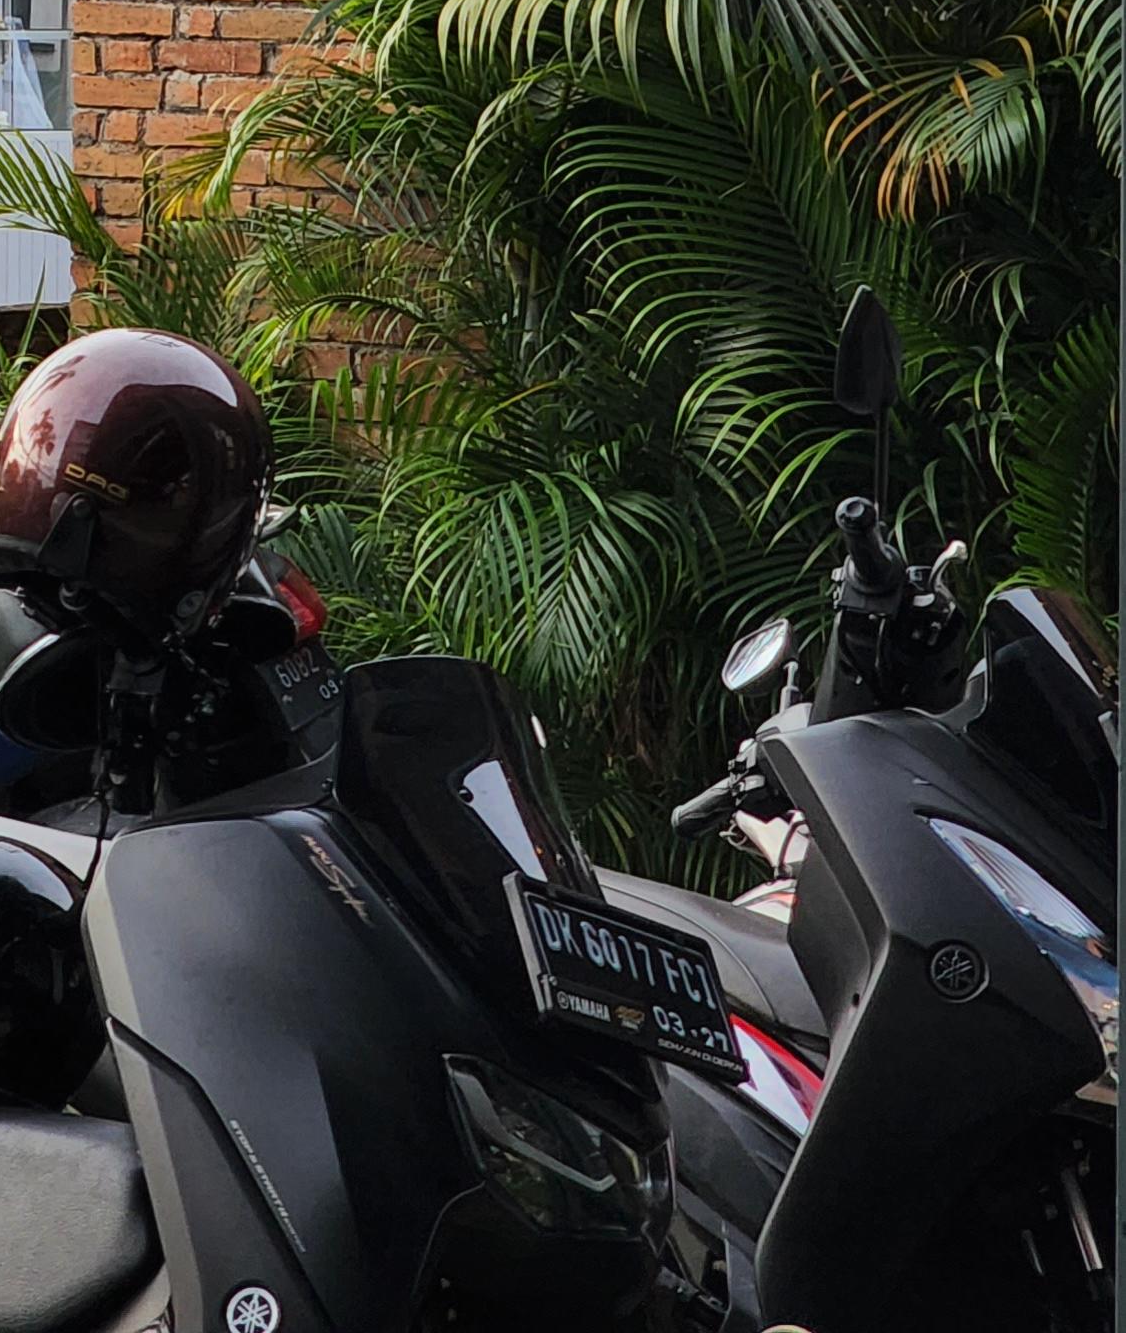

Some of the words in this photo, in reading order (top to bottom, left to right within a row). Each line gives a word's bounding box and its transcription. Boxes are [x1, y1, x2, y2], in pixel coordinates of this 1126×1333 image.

[274, 646, 320, 688] 6082
[533, 902, 584, 959] DK
[567, 993, 612, 1023] YAMAHA
